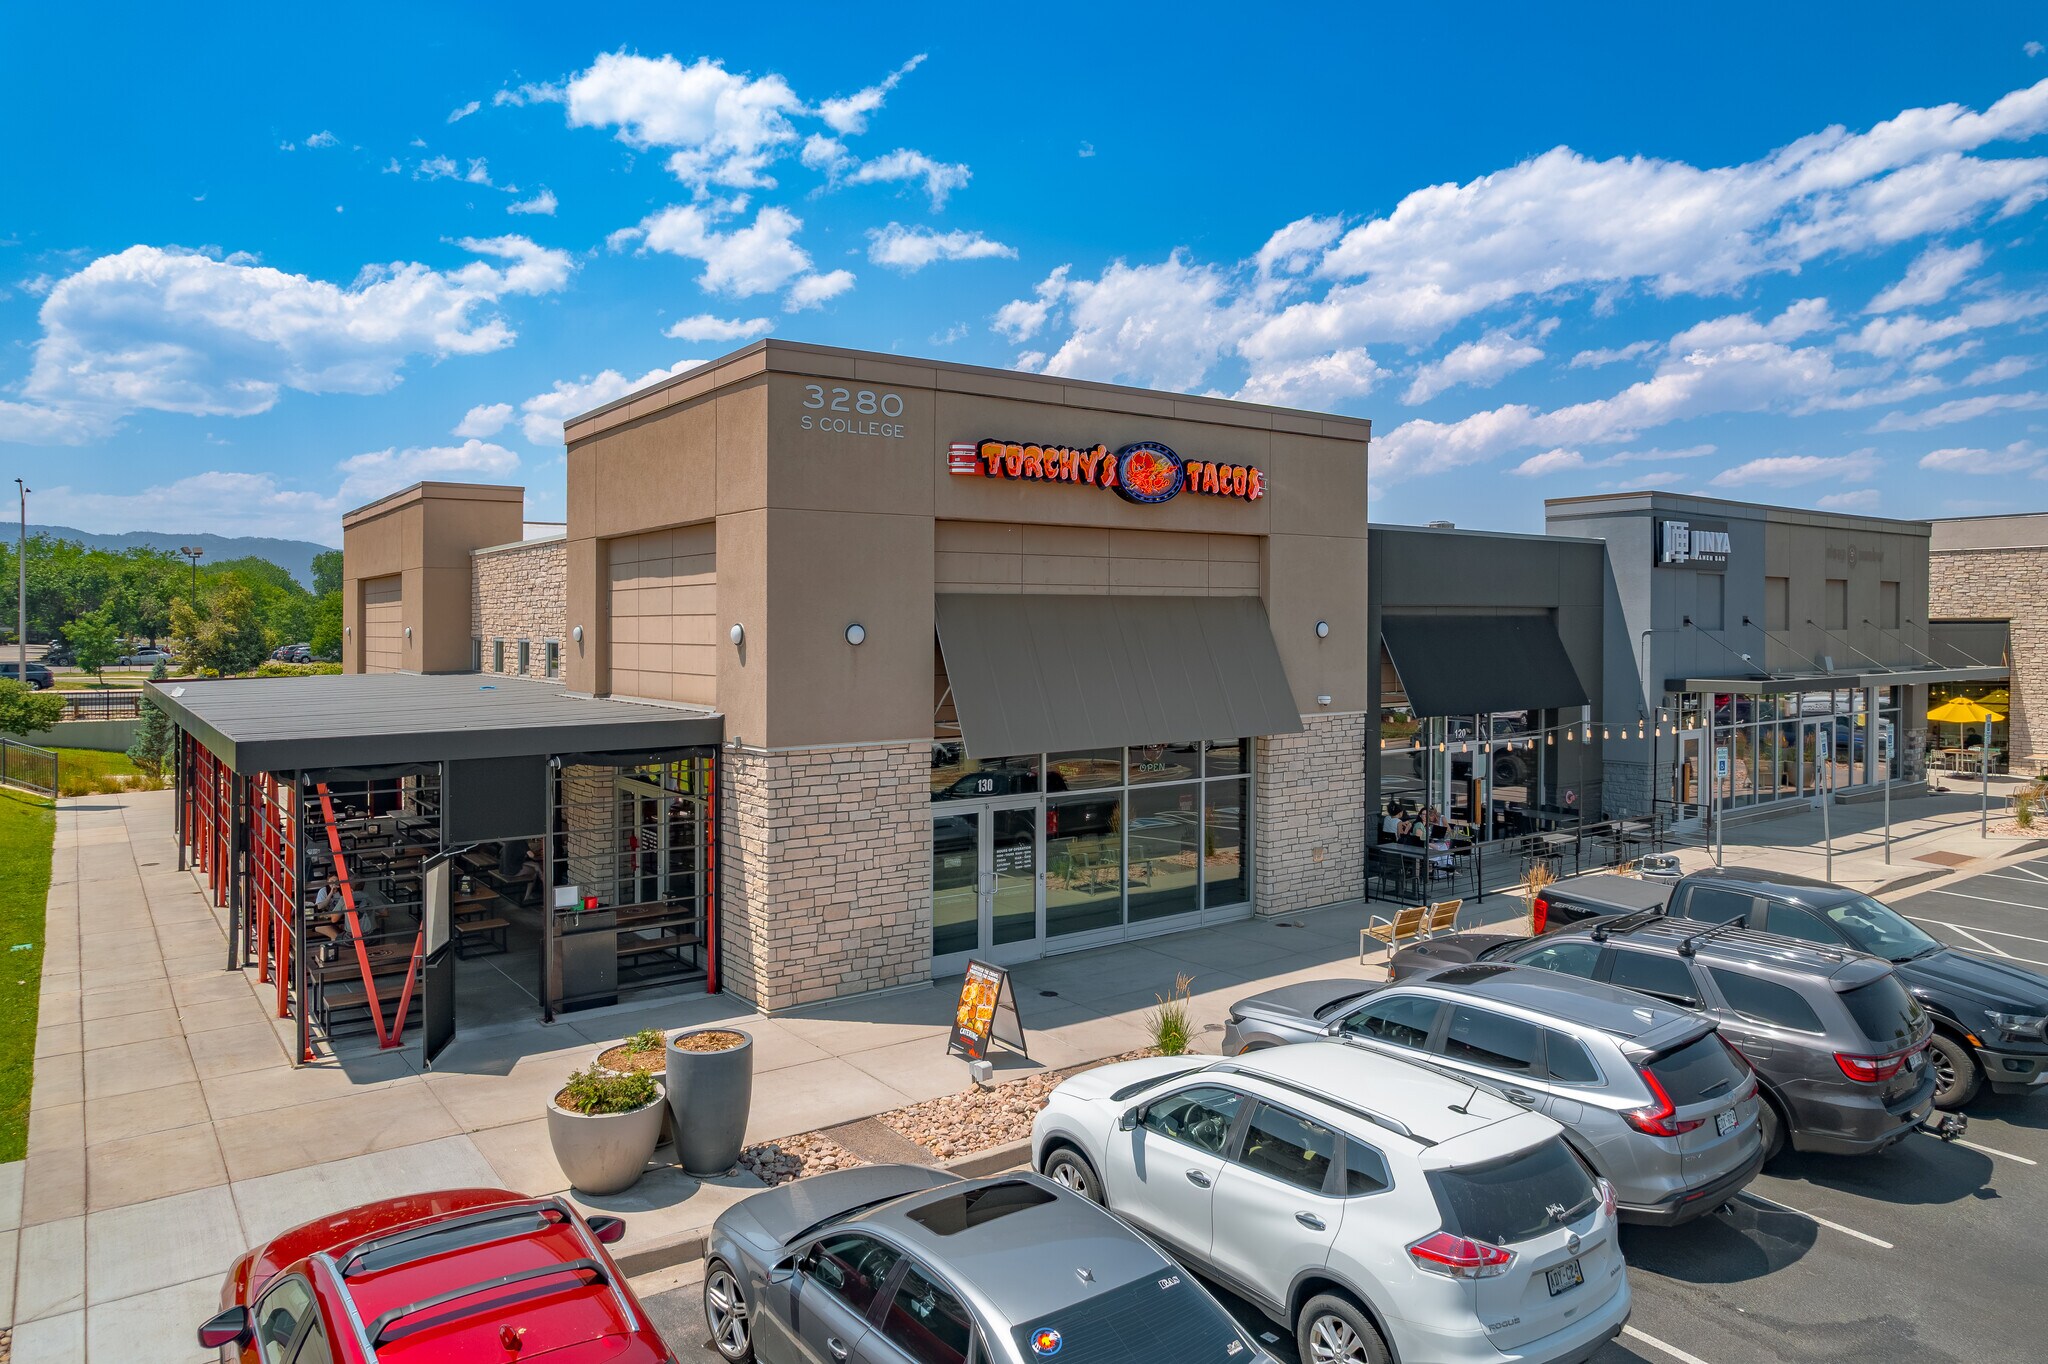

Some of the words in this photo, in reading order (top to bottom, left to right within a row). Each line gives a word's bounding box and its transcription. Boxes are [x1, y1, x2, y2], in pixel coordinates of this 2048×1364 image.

[802, 384, 904, 418] 3280
[800, 415, 813, 430] S
[819, 417, 905, 438] COLLEGE
[980, 442, 1118, 487] TORCHY'S
[1186, 461, 1261, 501] TACOS
[1690, 530, 1732, 560] JINYA
[1139, 762, 1165, 773] OPEN
[977, 778, 993, 793] 130
[1551, 901, 1591, 914] SPORT
[1487, 1316, 1521, 1332] ROGUE
